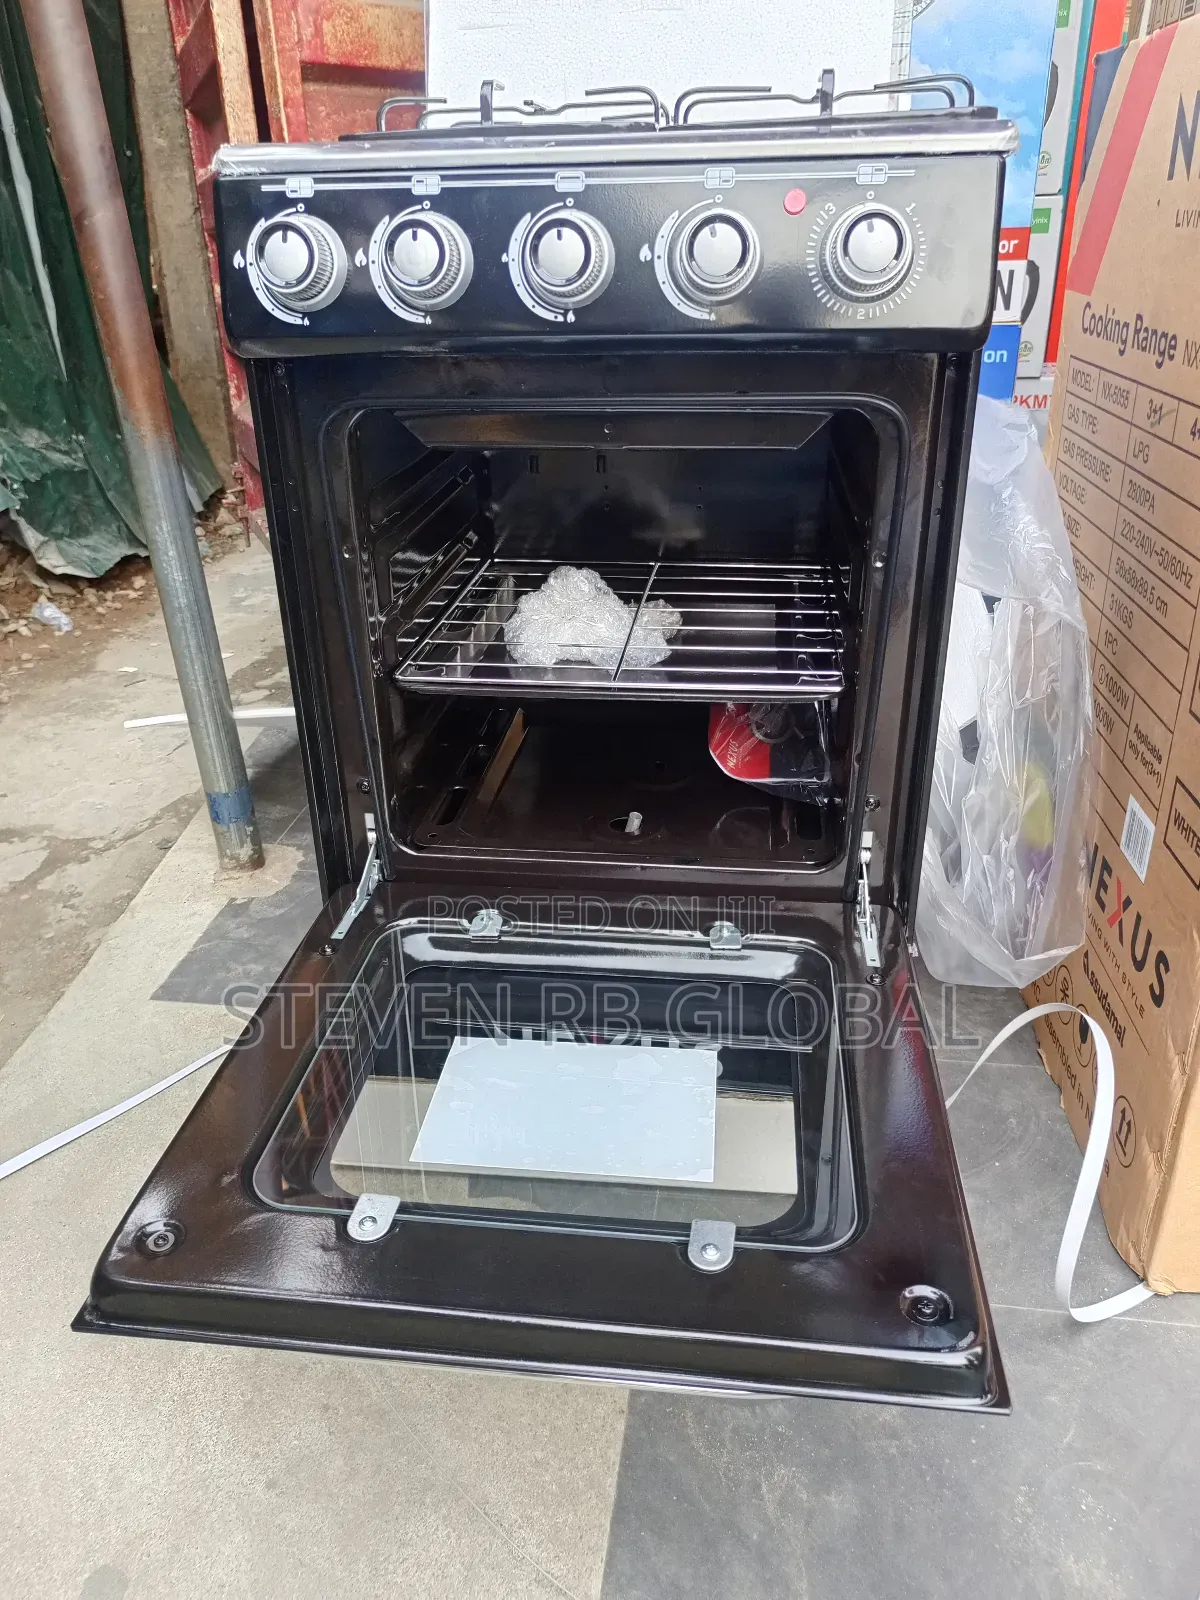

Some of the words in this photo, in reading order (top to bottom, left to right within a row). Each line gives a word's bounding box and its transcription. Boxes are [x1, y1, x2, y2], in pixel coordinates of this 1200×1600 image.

[1167, 90, 1200, 182] N
[1082, 301, 1130, 357] Cooking
[1131, 313, 1178, 369] Range
[1072, 367, 1095, 393] MODEL:
[1101, 380, 1130, 410] NX-5055
[1067, 403, 1080, 425] GAS
[1081, 410, 1099, 435] TYPE:
[1146, 398, 1164, 426] 3+1
[1062, 438, 1076, 459] GAS
[1075, 446, 1112, 483] PRESSURE:
[1132, 438, 1150, 464] LPG
[1060, 471, 1088, 505] VOLTAGE:
[1126, 479, 1155, 514] 2800PA
[1066, 514, 1082, 538] SIZE:
[1109, 593, 1134, 630] 31KGS
[1155, 596, 1168, 618] cm
[1103, 629, 1118, 656] 1PC
[1128, 740, 1140, 761] only
[1133, 723, 1162, 764] Applicable
[1103, 936, 1121, 973] WITH
[1121, 976, 1145, 1020] STYLE
[1044, 1014, 1077, 1093] ssembled
